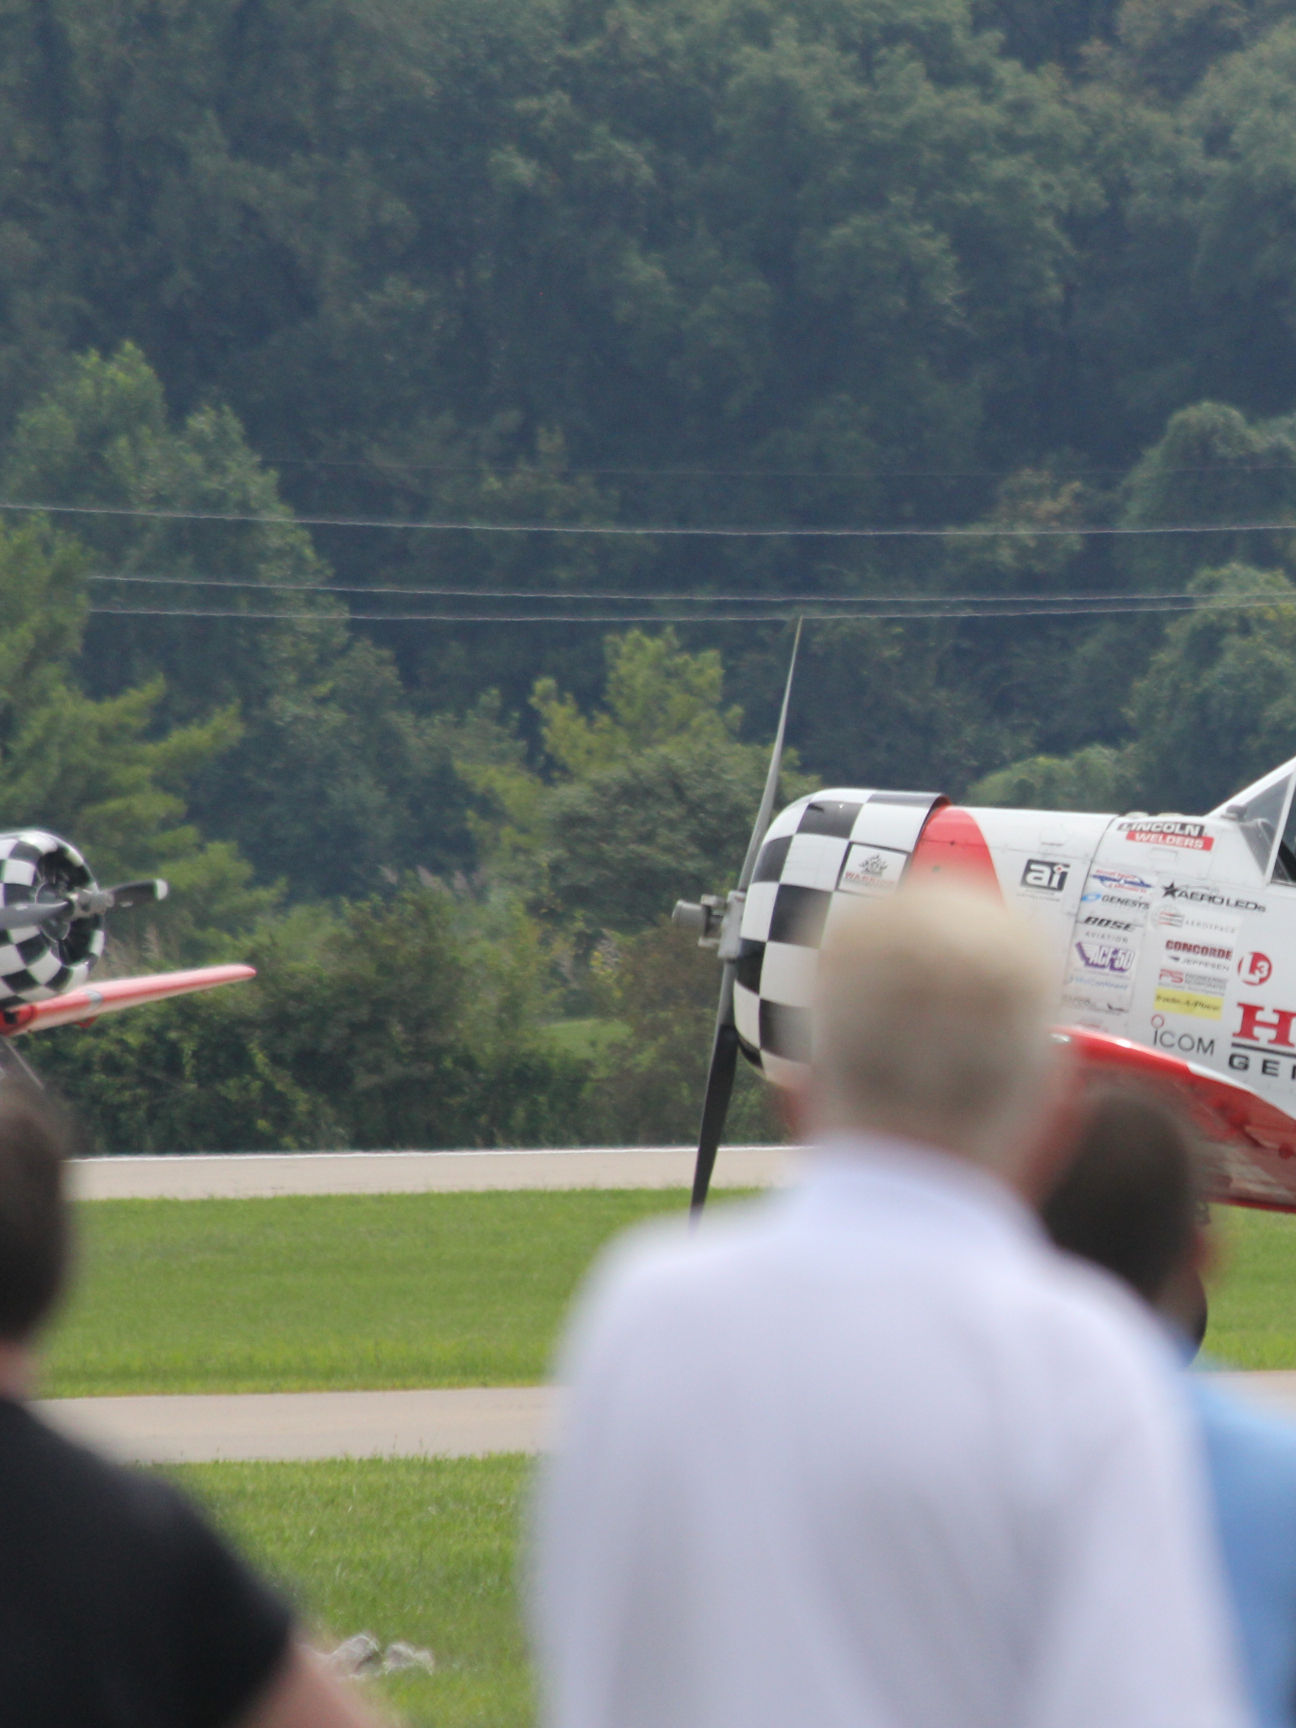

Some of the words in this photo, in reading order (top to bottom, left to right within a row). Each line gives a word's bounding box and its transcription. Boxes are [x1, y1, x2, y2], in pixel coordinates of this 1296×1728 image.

[1121, 822, 1201, 837] LINCOLN
[1135, 832, 1204, 849] WELDERS
[1101, 894, 1150, 910] GENESYS
[1084, 916, 1136, 932] BOSE
[1165, 940, 1233, 960] CONCORDE
